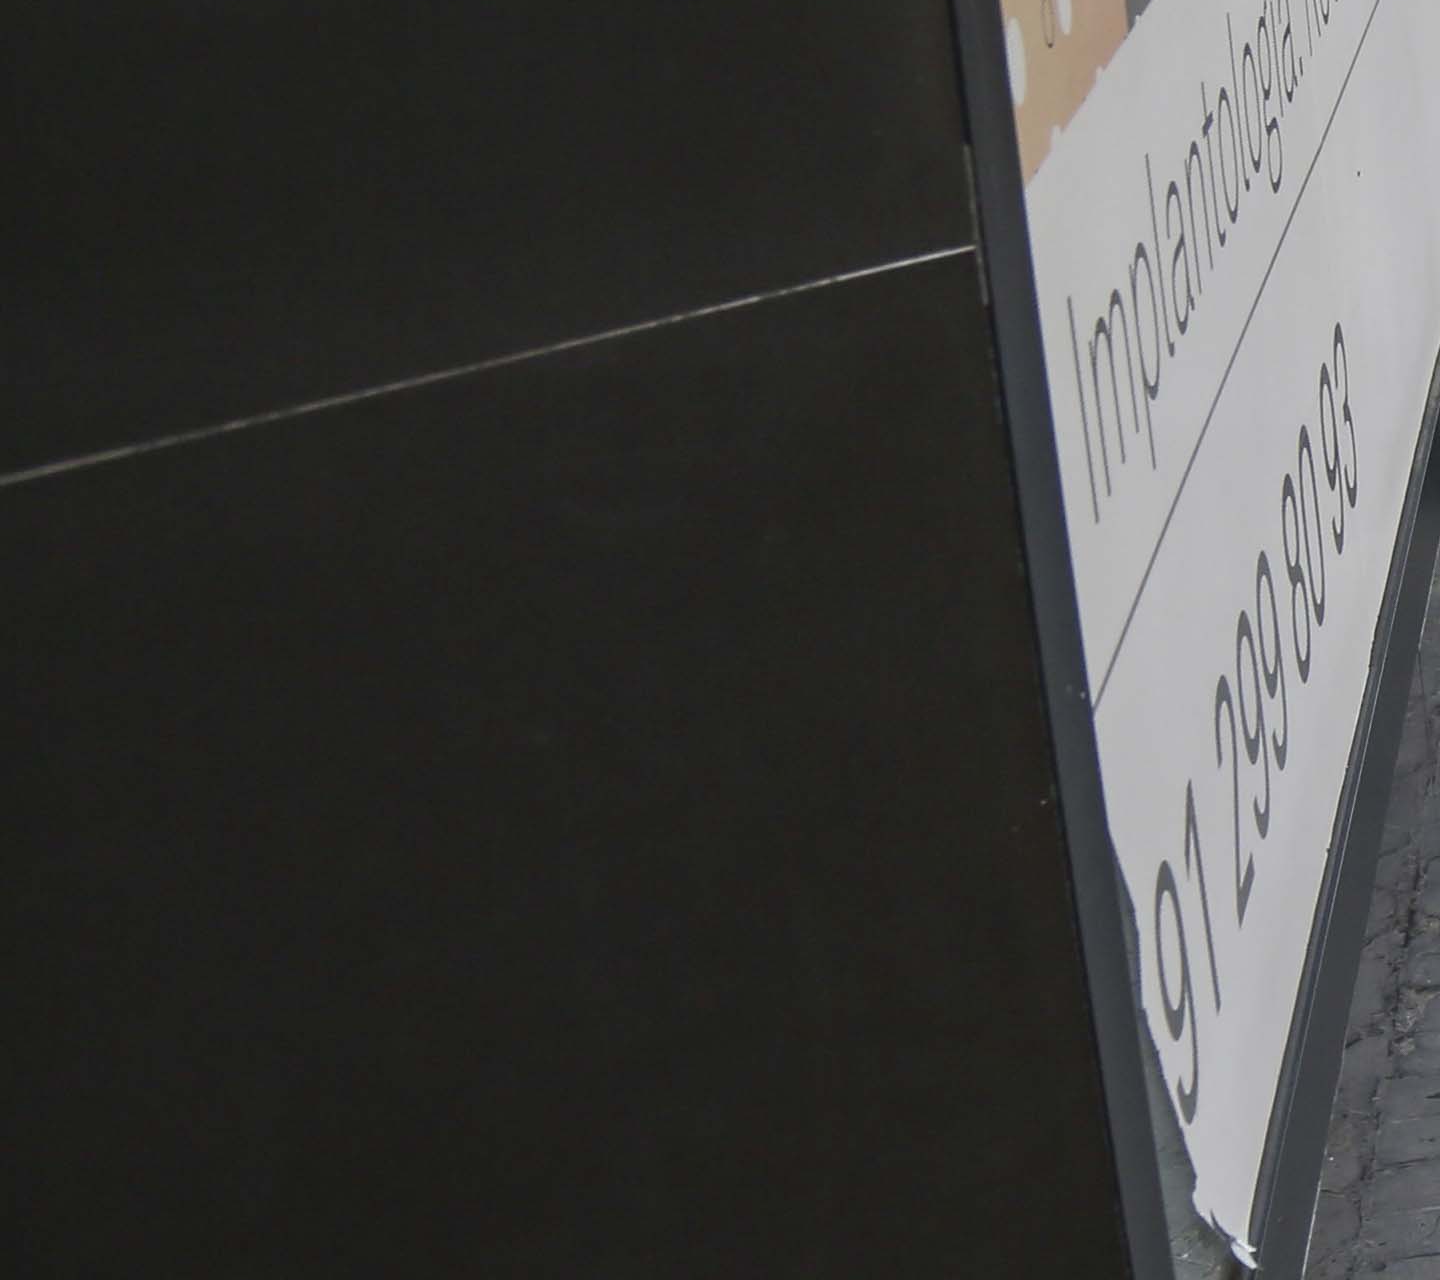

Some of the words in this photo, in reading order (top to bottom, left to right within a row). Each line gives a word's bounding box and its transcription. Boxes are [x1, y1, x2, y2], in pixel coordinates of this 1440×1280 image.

[1154, 778, 1221, 1126] 91
[1213, 548, 1288, 930] 299
[1281, 424, 1326, 685] 80
[1319, 321, 1358, 556] 93
